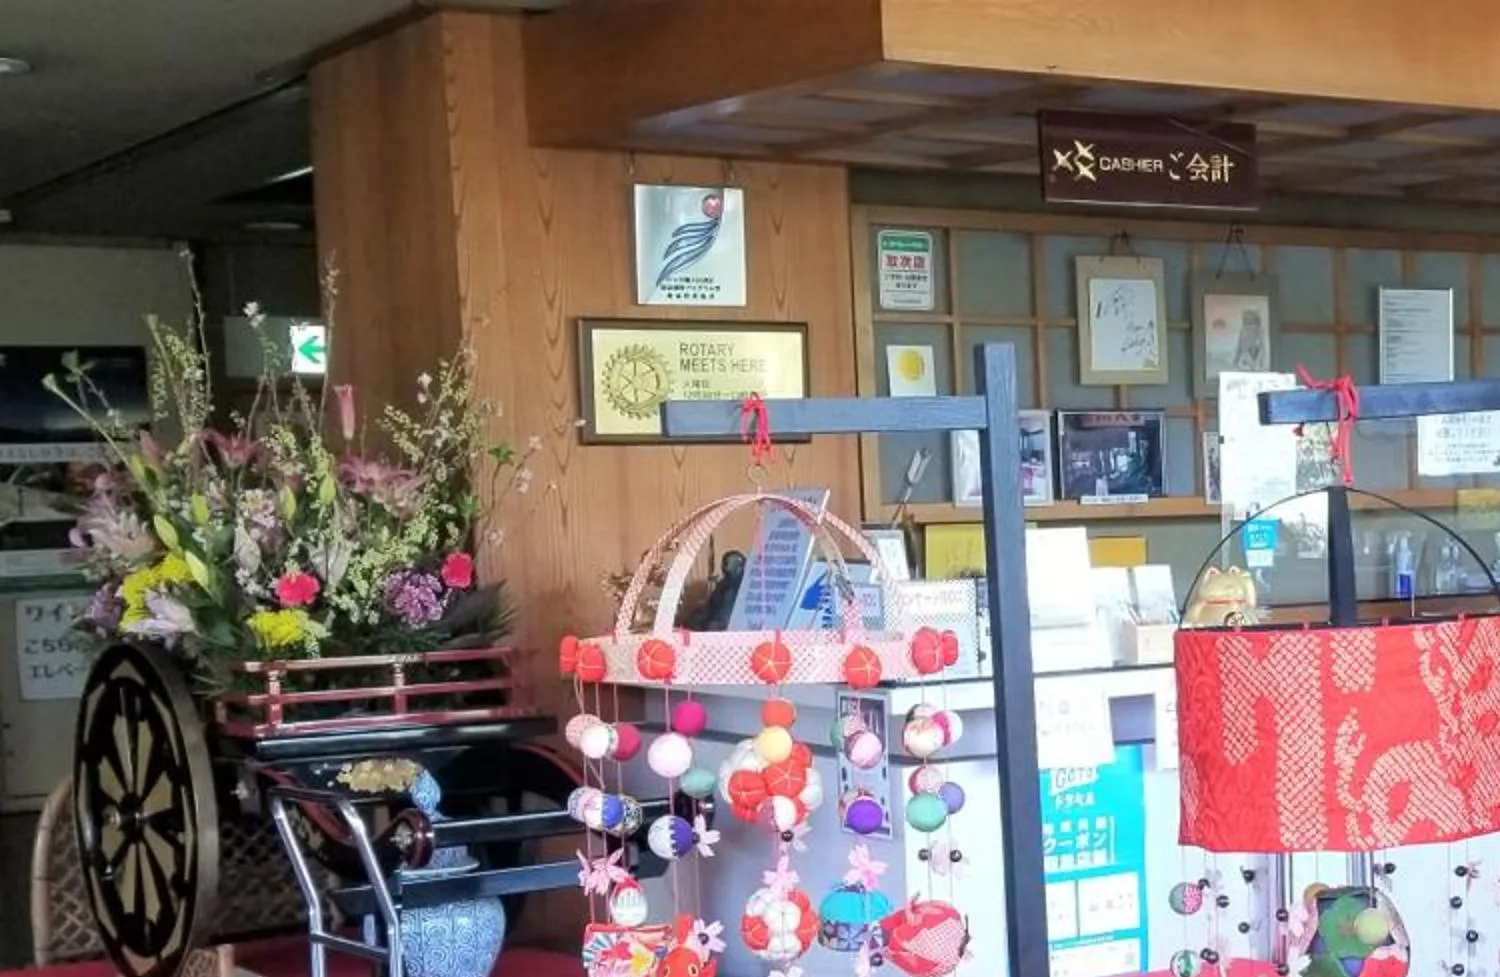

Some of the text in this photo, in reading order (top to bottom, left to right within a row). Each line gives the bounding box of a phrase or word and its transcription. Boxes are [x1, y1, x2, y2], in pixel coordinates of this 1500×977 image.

[1099, 151, 1236, 183] CASHIER ご会計
[679, 342, 735, 357] ROTARY
[679, 357, 767, 374] MEETS HERE
